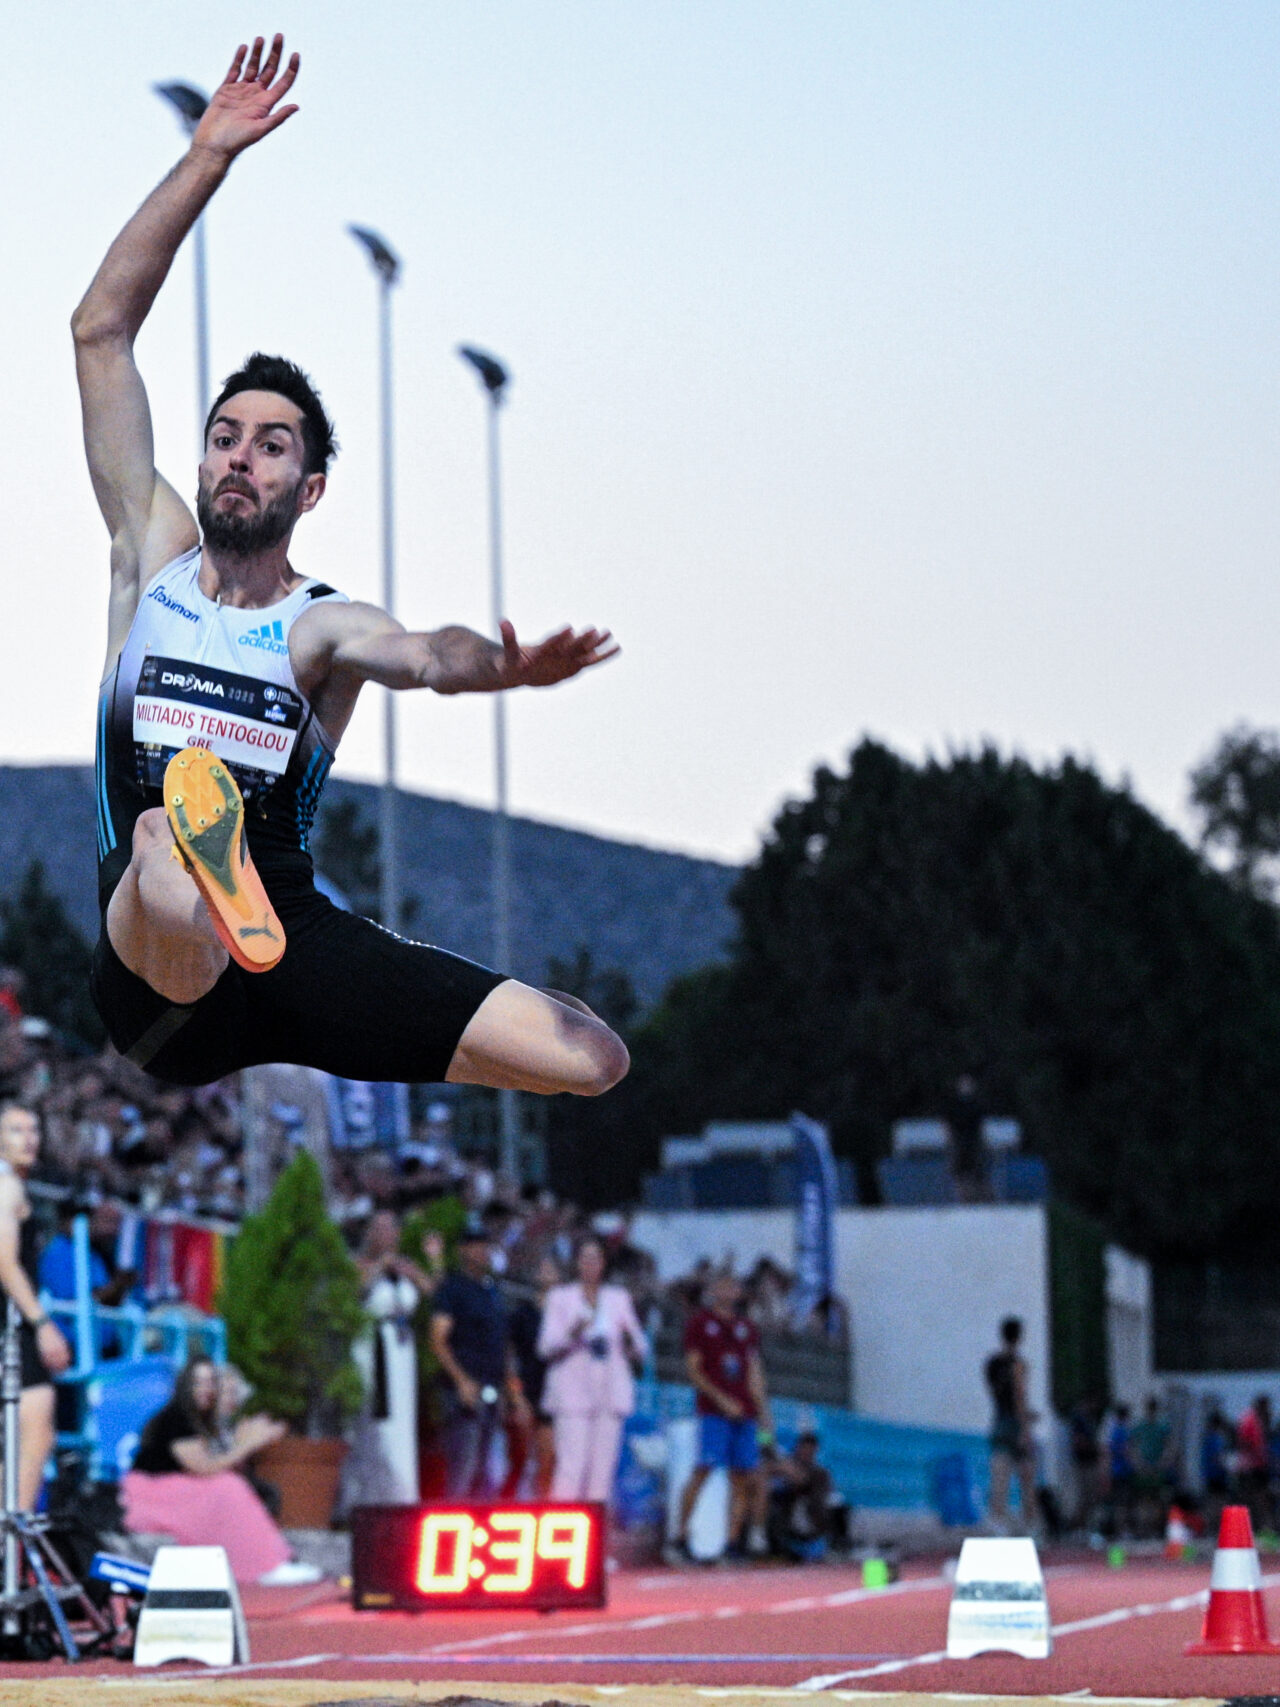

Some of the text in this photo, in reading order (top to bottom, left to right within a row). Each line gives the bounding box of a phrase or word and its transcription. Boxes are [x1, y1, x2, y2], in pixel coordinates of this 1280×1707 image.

[238, 634, 289, 656] adidas
[161, 671, 225, 698] DROMIA
[136, 703, 196, 729] MILTIADIS
[200, 714, 289, 752] TENTOGLOU
[187, 735, 214, 752] GRE
[417, 1512, 591, 1593] 0:39
